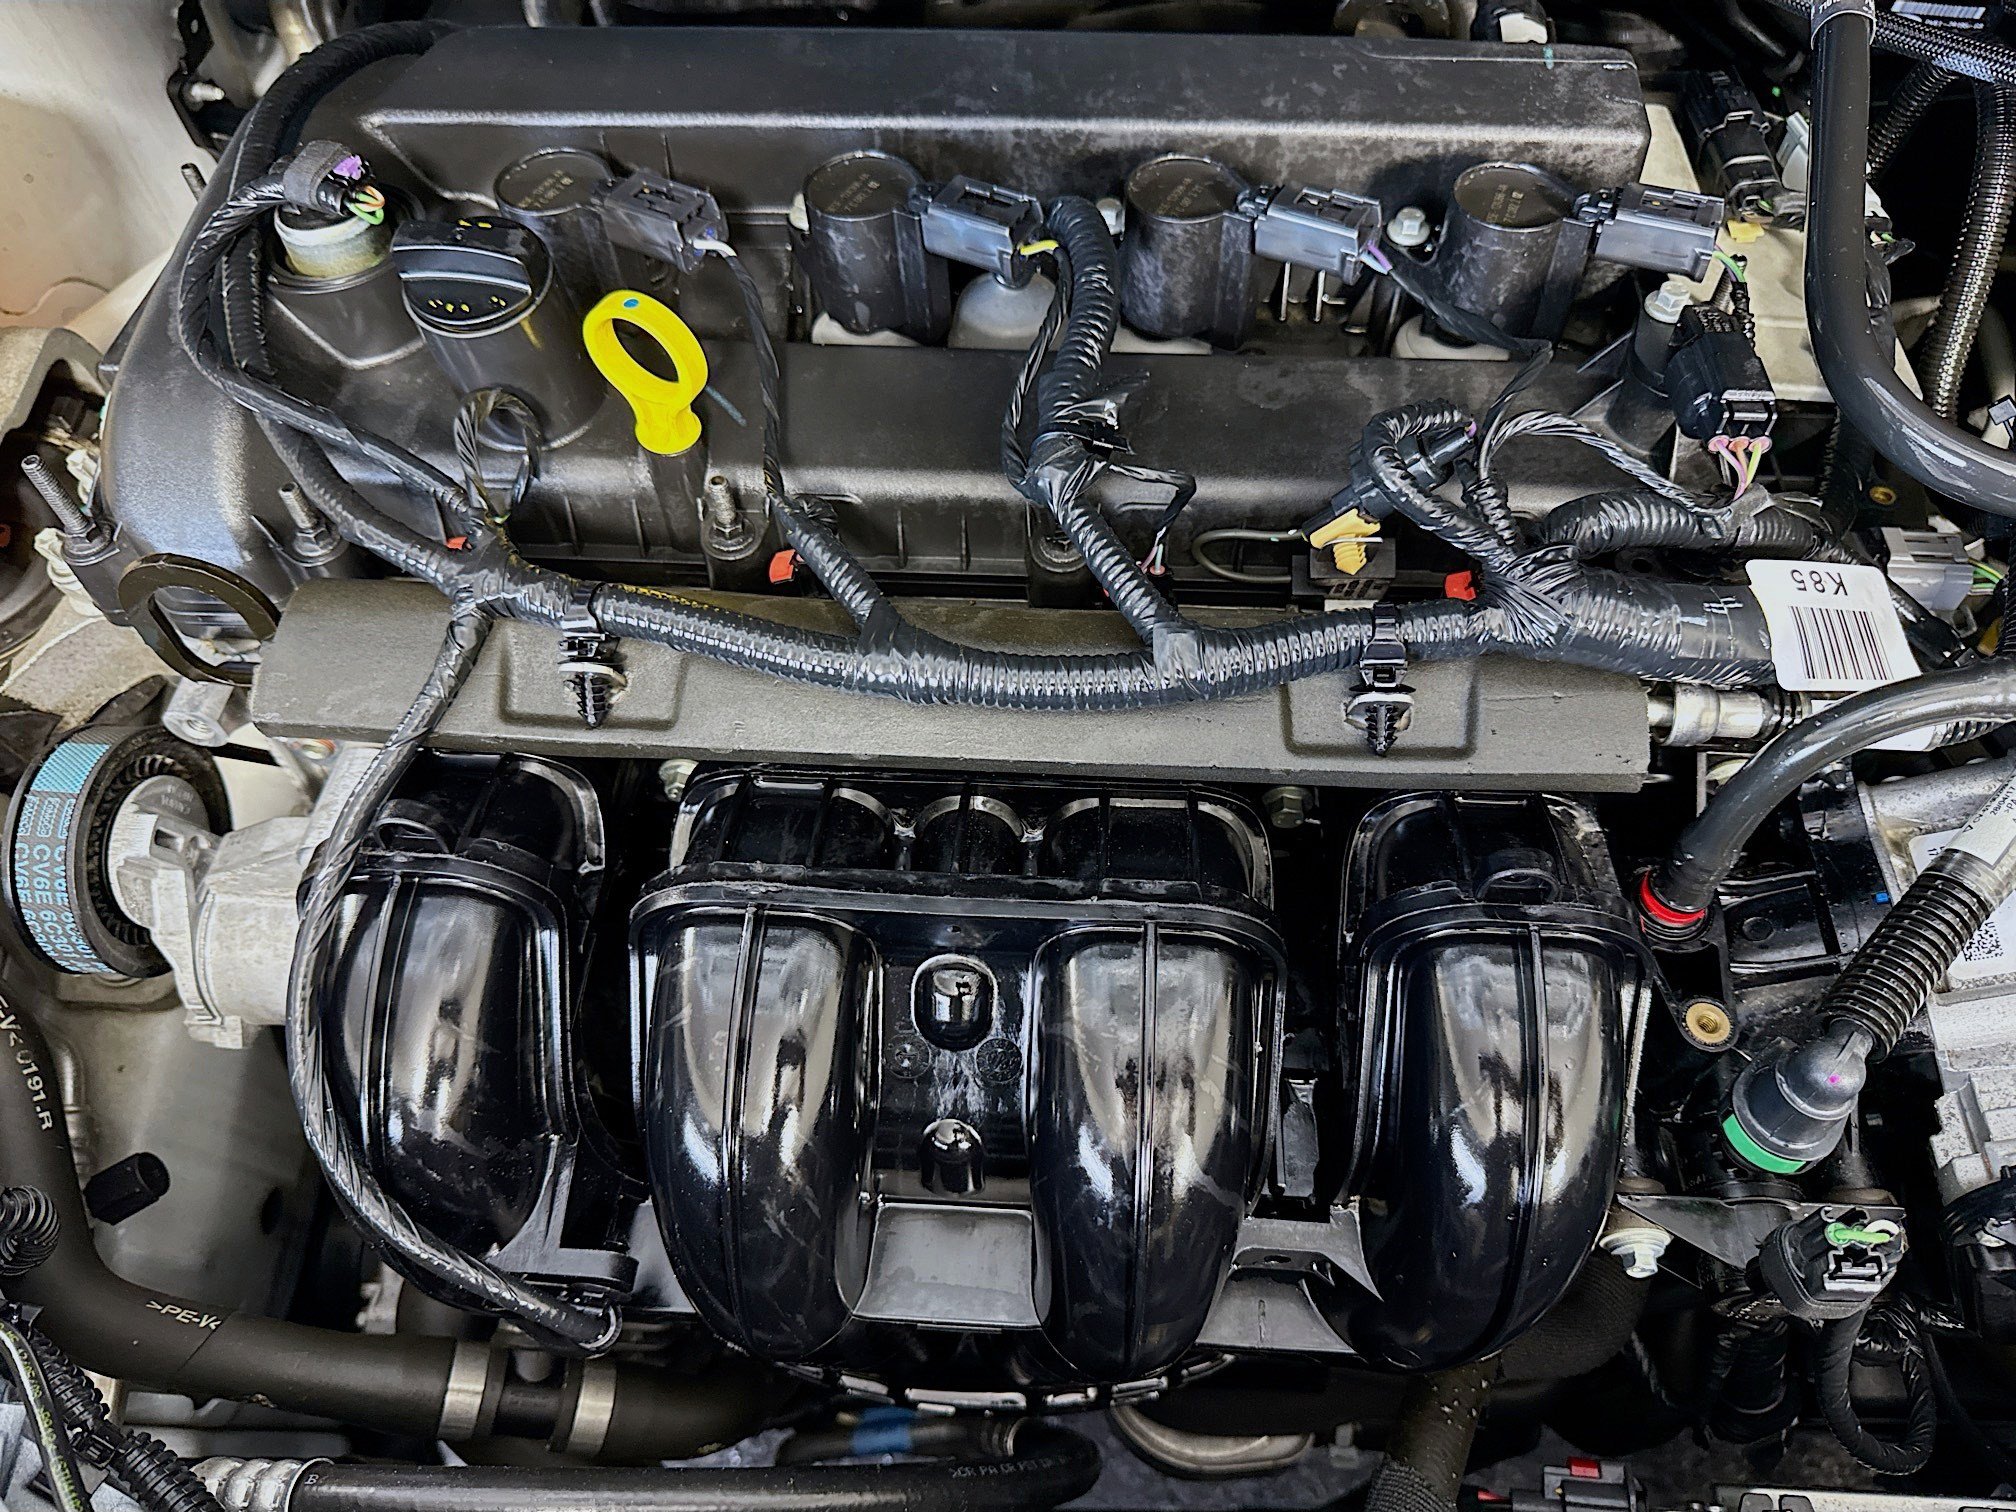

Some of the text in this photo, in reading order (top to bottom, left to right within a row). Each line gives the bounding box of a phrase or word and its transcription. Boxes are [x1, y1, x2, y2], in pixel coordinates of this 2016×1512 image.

[1790, 568, 1849, 597] K85
[32, 843, 53, 905] CV6E
[39, 910, 74, 961] 6C301
[15, 1049, 53, 1131] 0191.R
[304, 1473, 320, 1485] B
